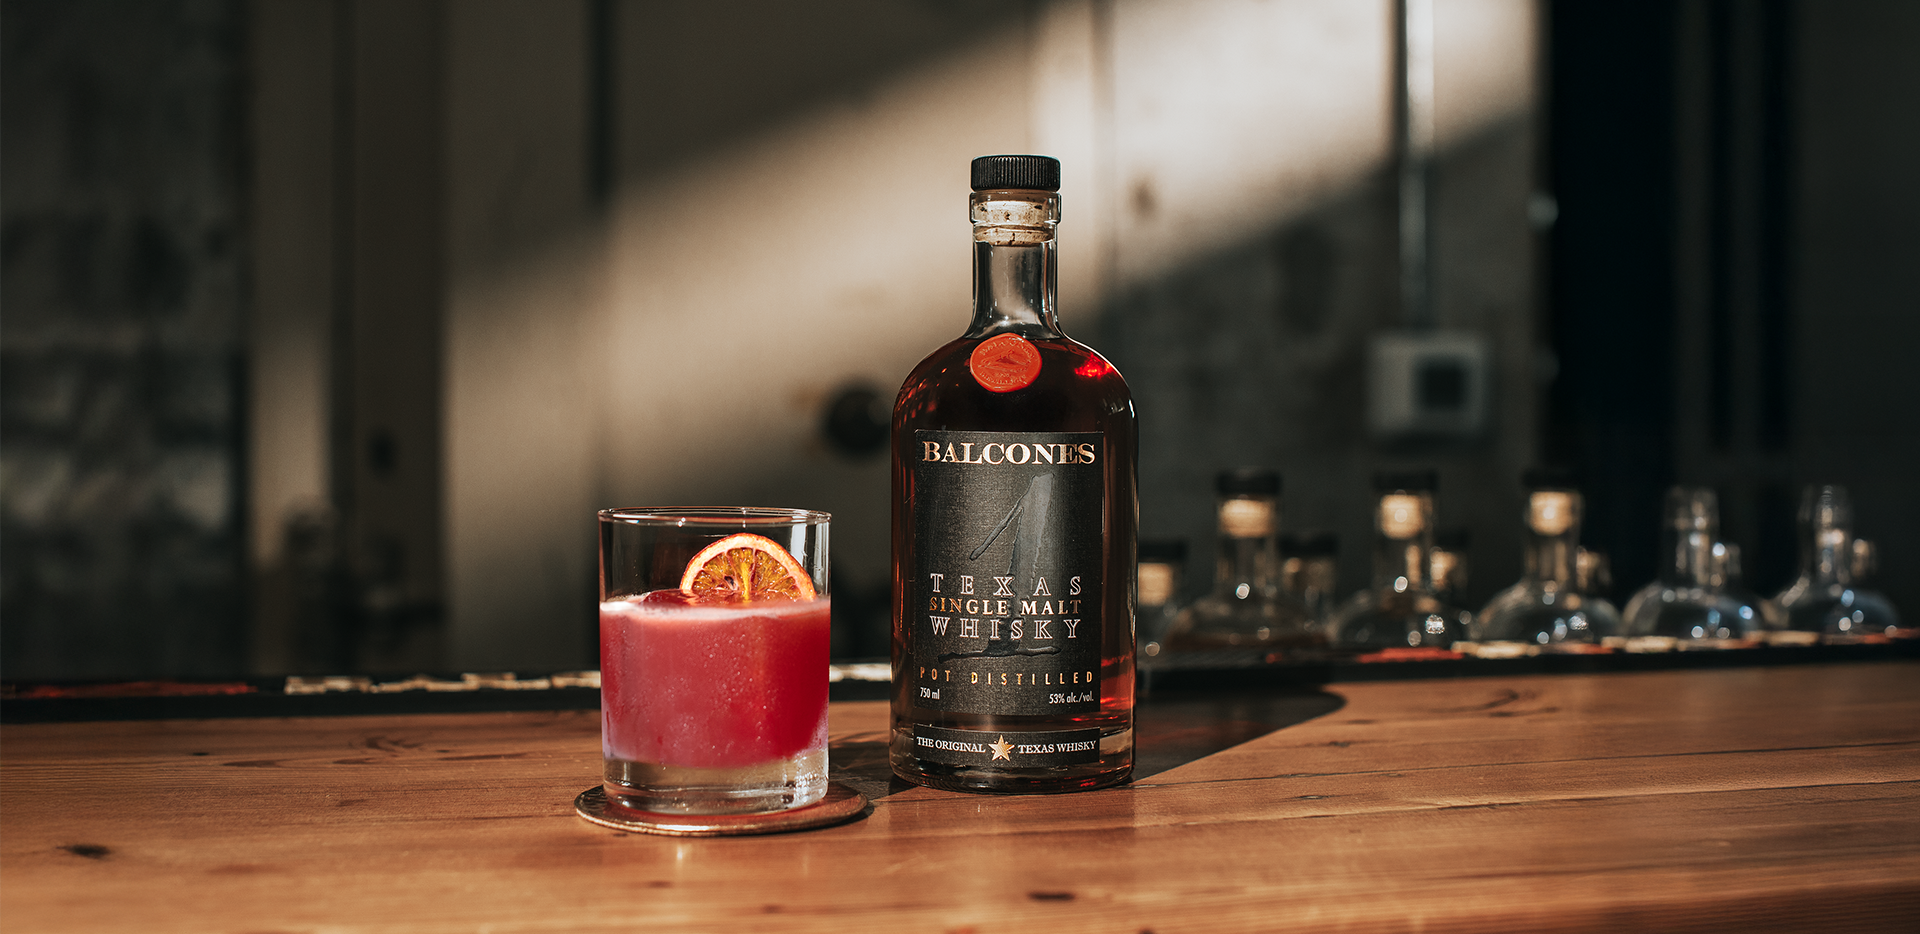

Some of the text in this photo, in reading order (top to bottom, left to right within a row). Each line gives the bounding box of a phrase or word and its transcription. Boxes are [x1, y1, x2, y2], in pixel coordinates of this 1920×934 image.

[922, 441, 1096, 465] BALCONES
[930, 573, 1082, 597] TEXAS
[929, 597, 1082, 616] SINGLE MALT
[929, 616, 1081, 640] WHISKY
[920, 666, 1093, 685] POT DISTILLED
[920, 687, 940, 700] 750 ml
[1049, 690, 1094, 704] 53% alc./vol.
[916, 737, 1096, 754] THE ORIGINAL TEXAS WHISKY
